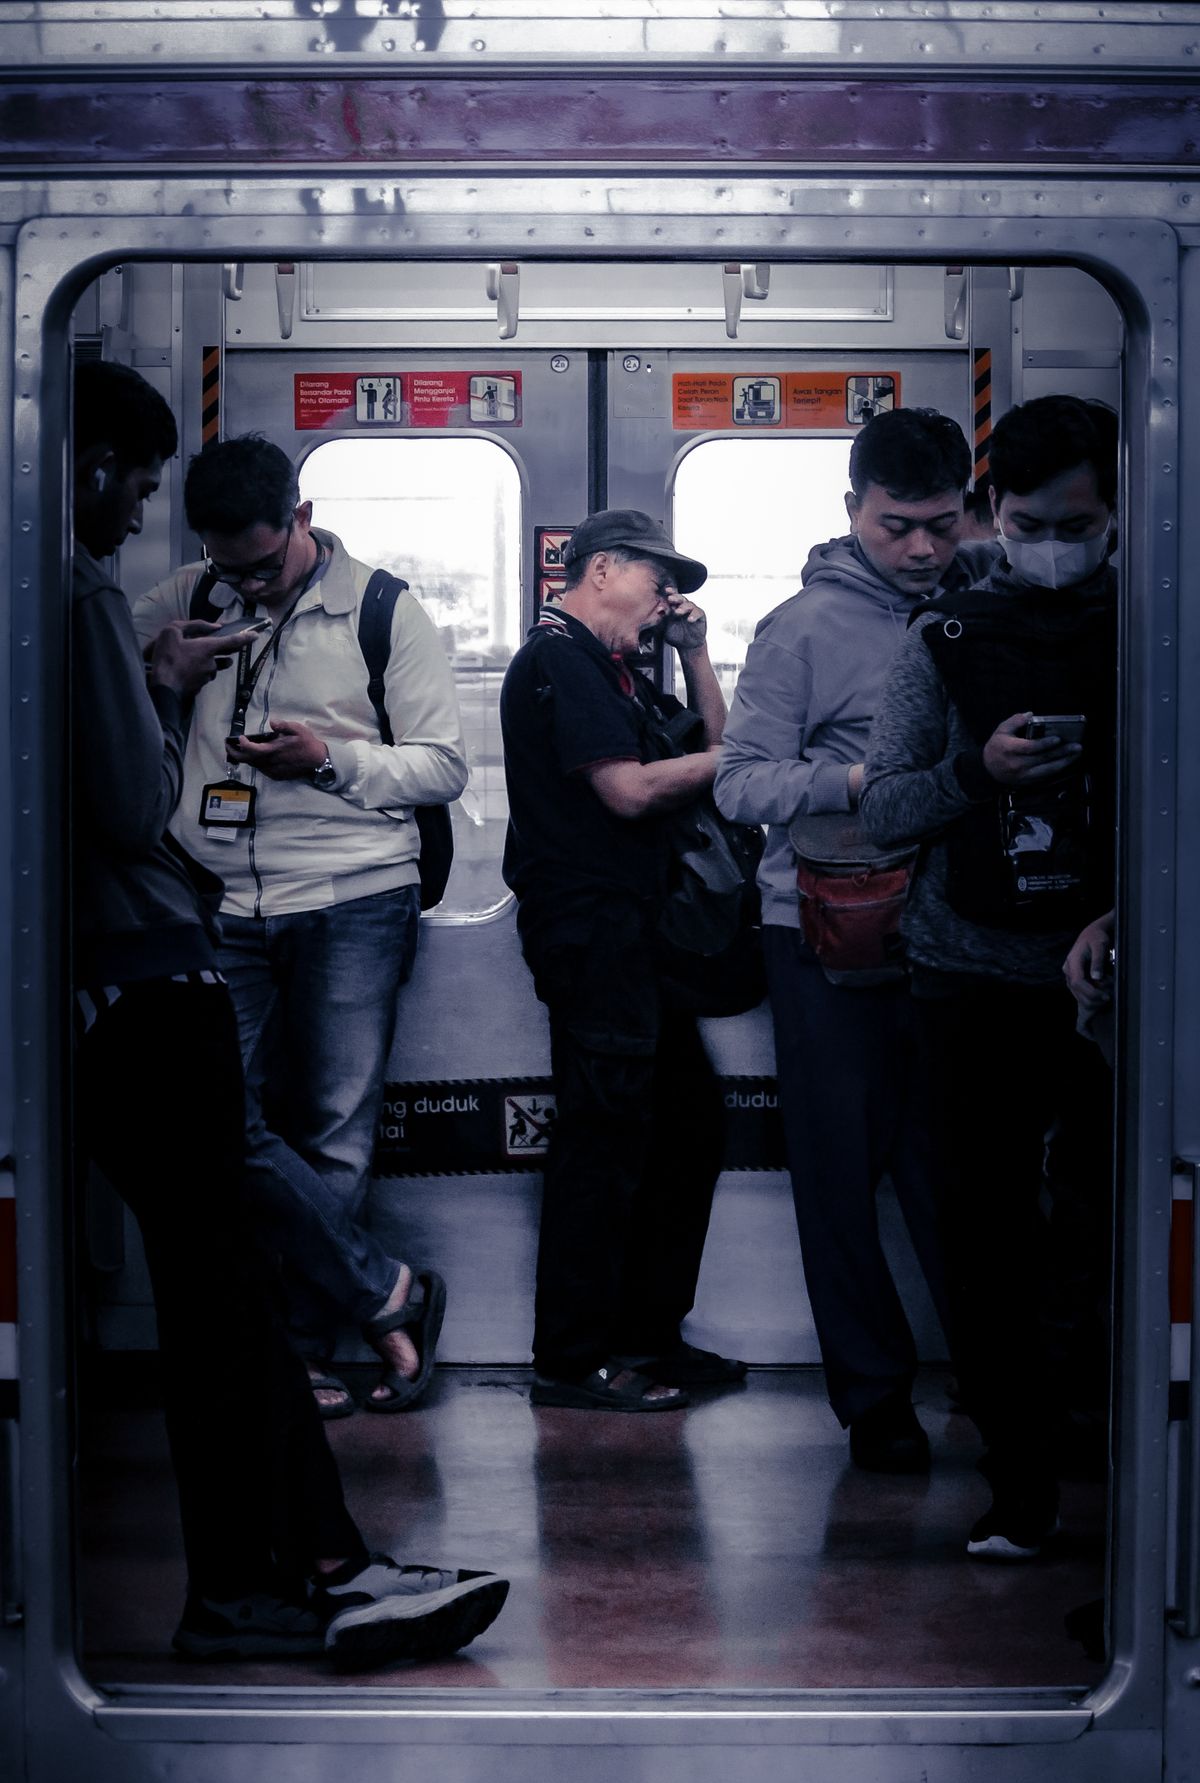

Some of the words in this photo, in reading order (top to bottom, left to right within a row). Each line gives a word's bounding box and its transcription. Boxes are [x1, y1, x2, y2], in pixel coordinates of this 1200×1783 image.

[414, 379, 443, 387] Dilarang
[414, 387, 455, 396] Mengganjal
[814, 387, 842, 397] Tangan
[413, 1094, 480, 1114] duduk
[723, 1090, 779, 1108] dudu
